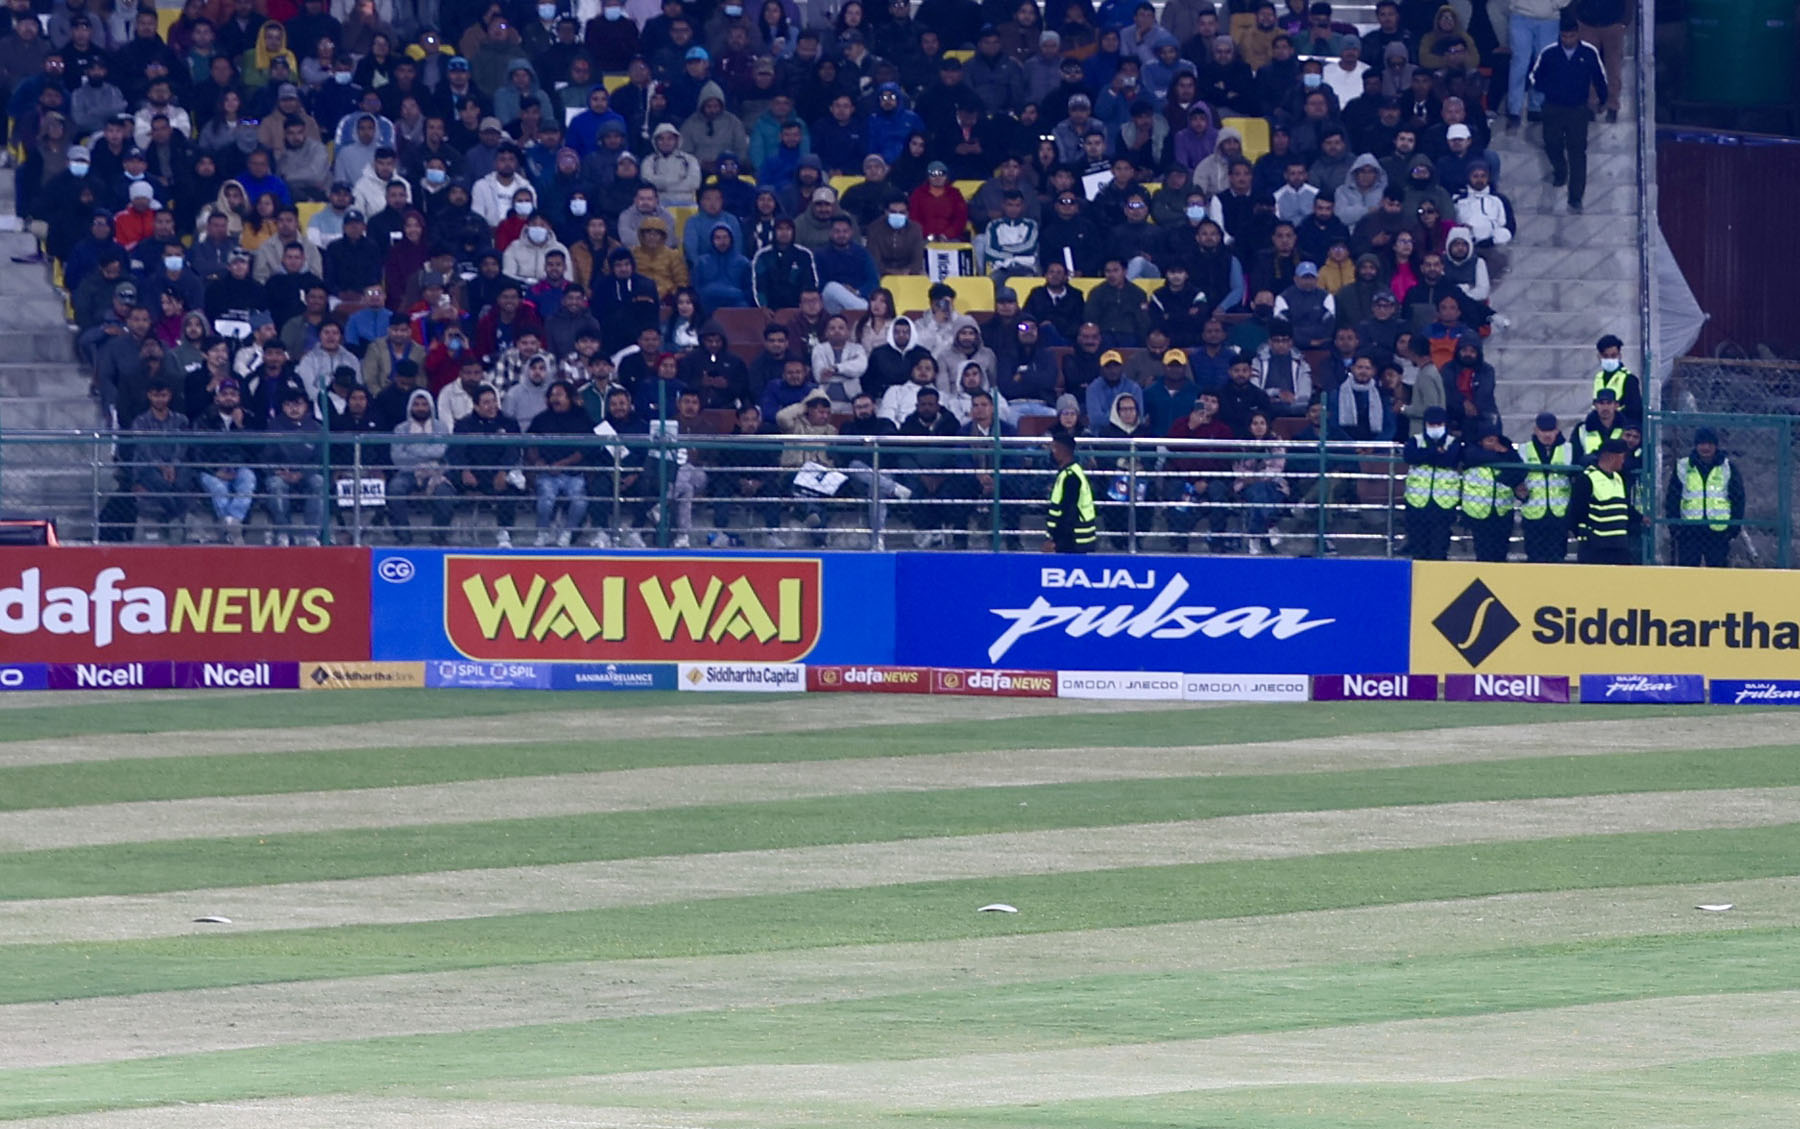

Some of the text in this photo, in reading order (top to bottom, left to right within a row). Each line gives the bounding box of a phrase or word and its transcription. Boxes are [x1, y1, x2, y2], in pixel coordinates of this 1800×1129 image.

[383, 563, 410, 577] CG
[1041, 568, 1155, 589] BAJAJ
[461, 573, 801, 645] WAI WAI
[77, 662, 143, 687] Ncell
[203, 663, 270, 687] Ncell
[458, 664, 485, 677] SPIL
[509, 665, 536, 678] SPIL
[706, 666, 799, 686] Siddhartha Capital
[1063, 679, 1178, 690] OMODA JAECOO
[1187, 682, 1304, 693] OMODA JAECOO
[1343, 674, 1408, 697] Ncell
[1474, 674, 1540, 697] Ncell
